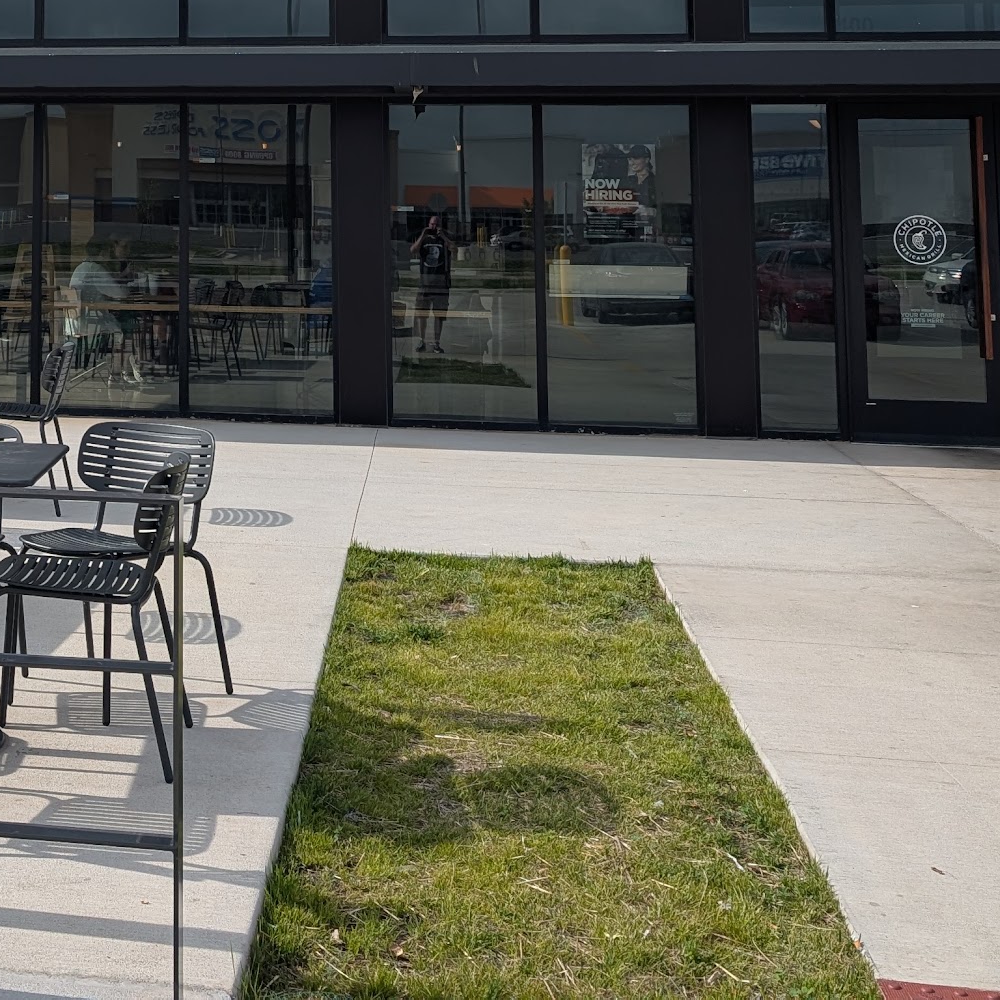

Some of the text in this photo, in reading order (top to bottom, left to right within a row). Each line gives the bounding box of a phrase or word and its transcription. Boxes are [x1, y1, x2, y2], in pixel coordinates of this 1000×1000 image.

[585, 178, 620, 190] NOW
[585, 189, 633, 201] HIRING
[898, 218, 943, 237] CHIPOTLE
[899, 243, 942, 261] MEXICAN GRILL
